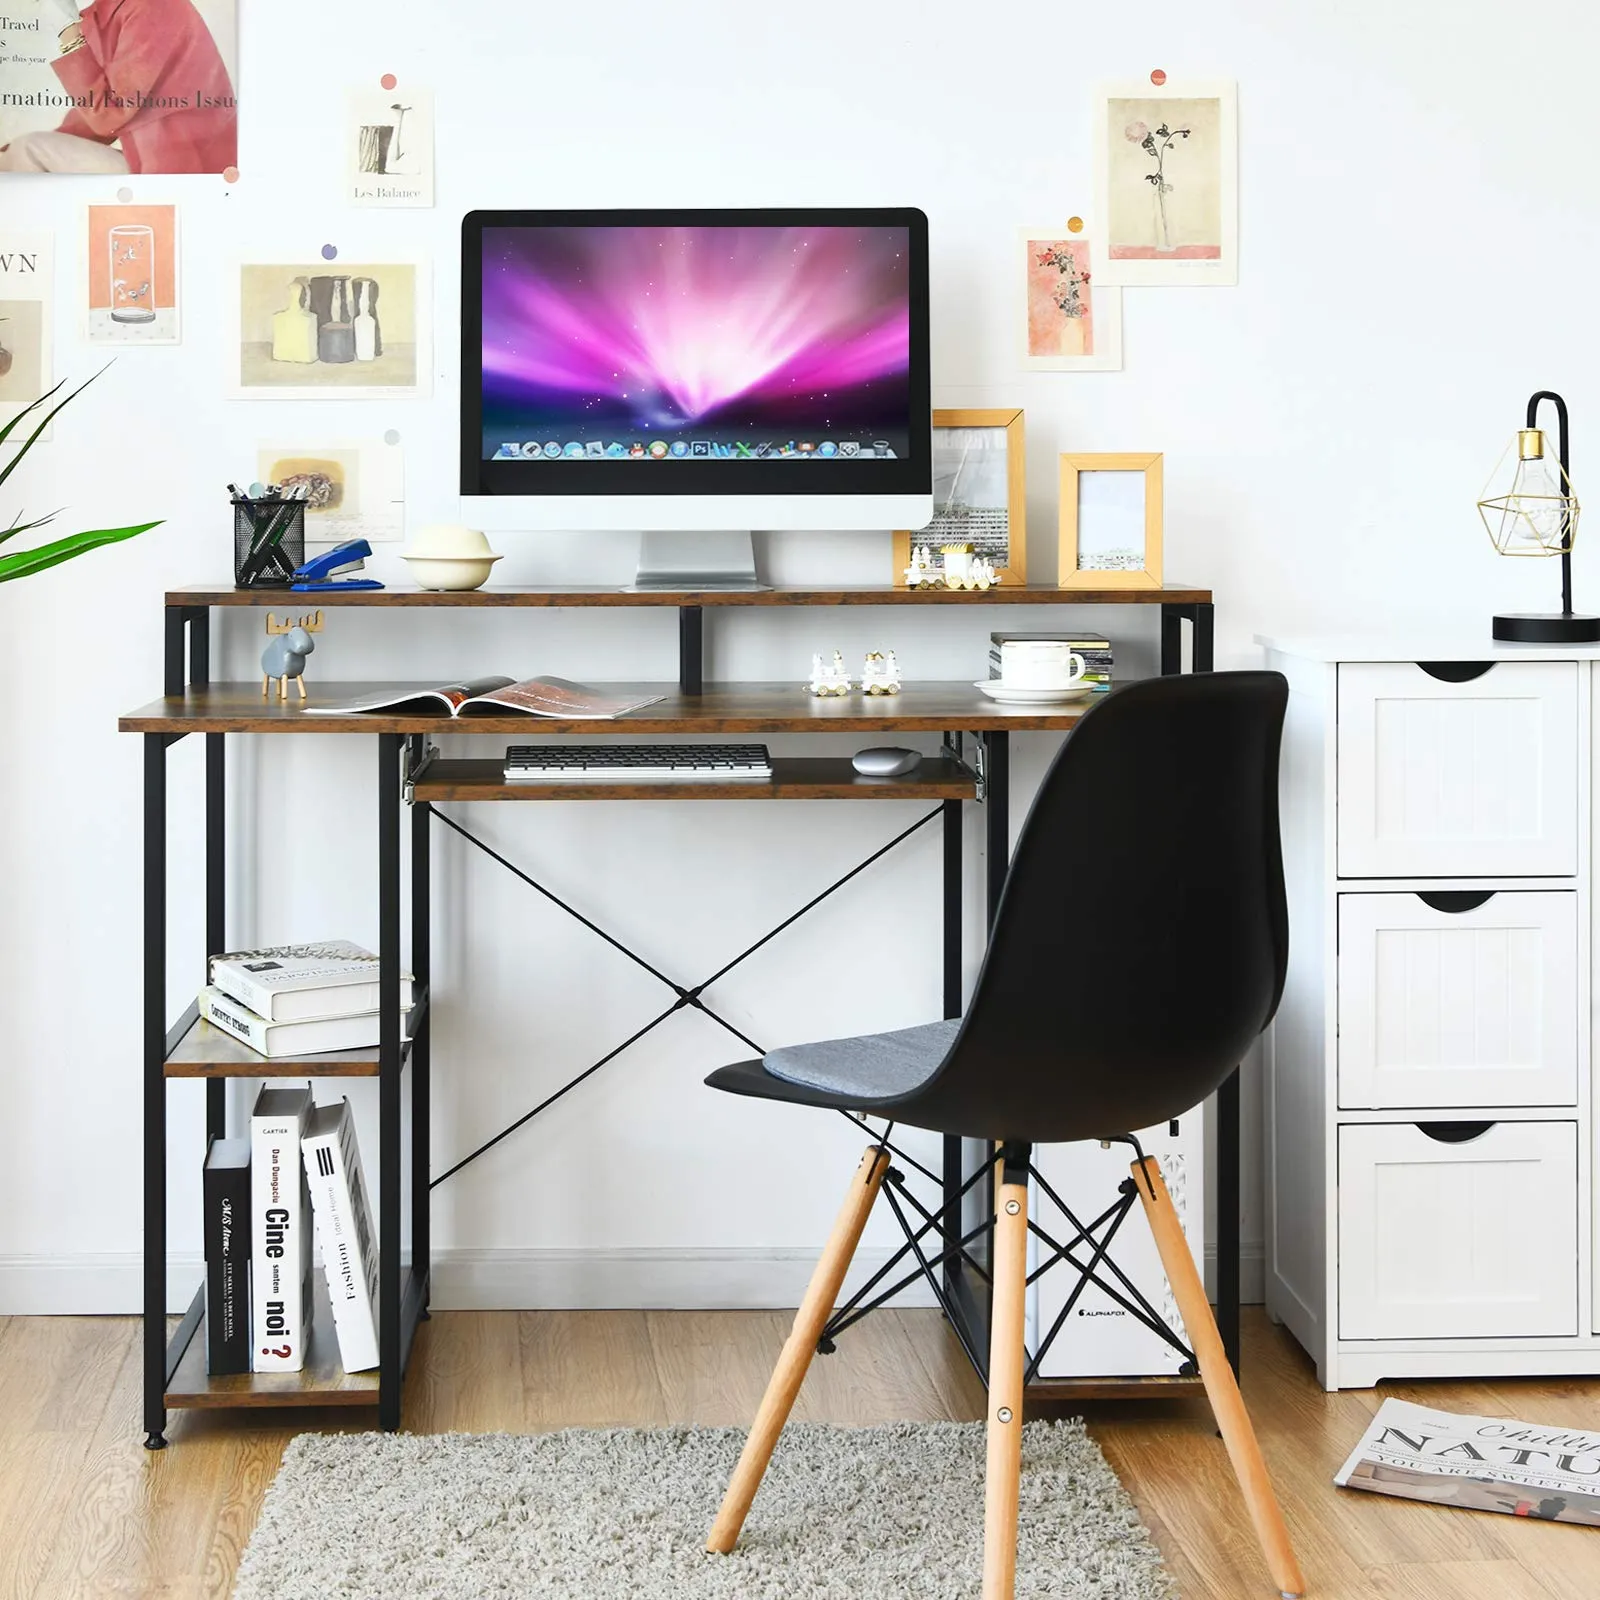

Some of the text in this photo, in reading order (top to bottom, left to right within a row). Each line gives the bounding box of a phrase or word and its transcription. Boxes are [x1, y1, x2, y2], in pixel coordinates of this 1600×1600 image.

[0, 16, 39, 31] Travel
[12, 54, 27, 63] this
[29, 57, 47, 66] year
[2, 88, 238, 109] rnational Fashions Issu
[354, 187, 421, 199] Les Balance
[270, 1148, 280, 1204] Dan Dungaciu
[265, 1208, 290, 1259] Cine
[338, 1242, 356, 1300] Fashion
[1377, 1454, 1422, 1468] YOU
[1432, 1466, 1477, 1475] ARE
[1486, 1471, 1567, 1488] SWEET
